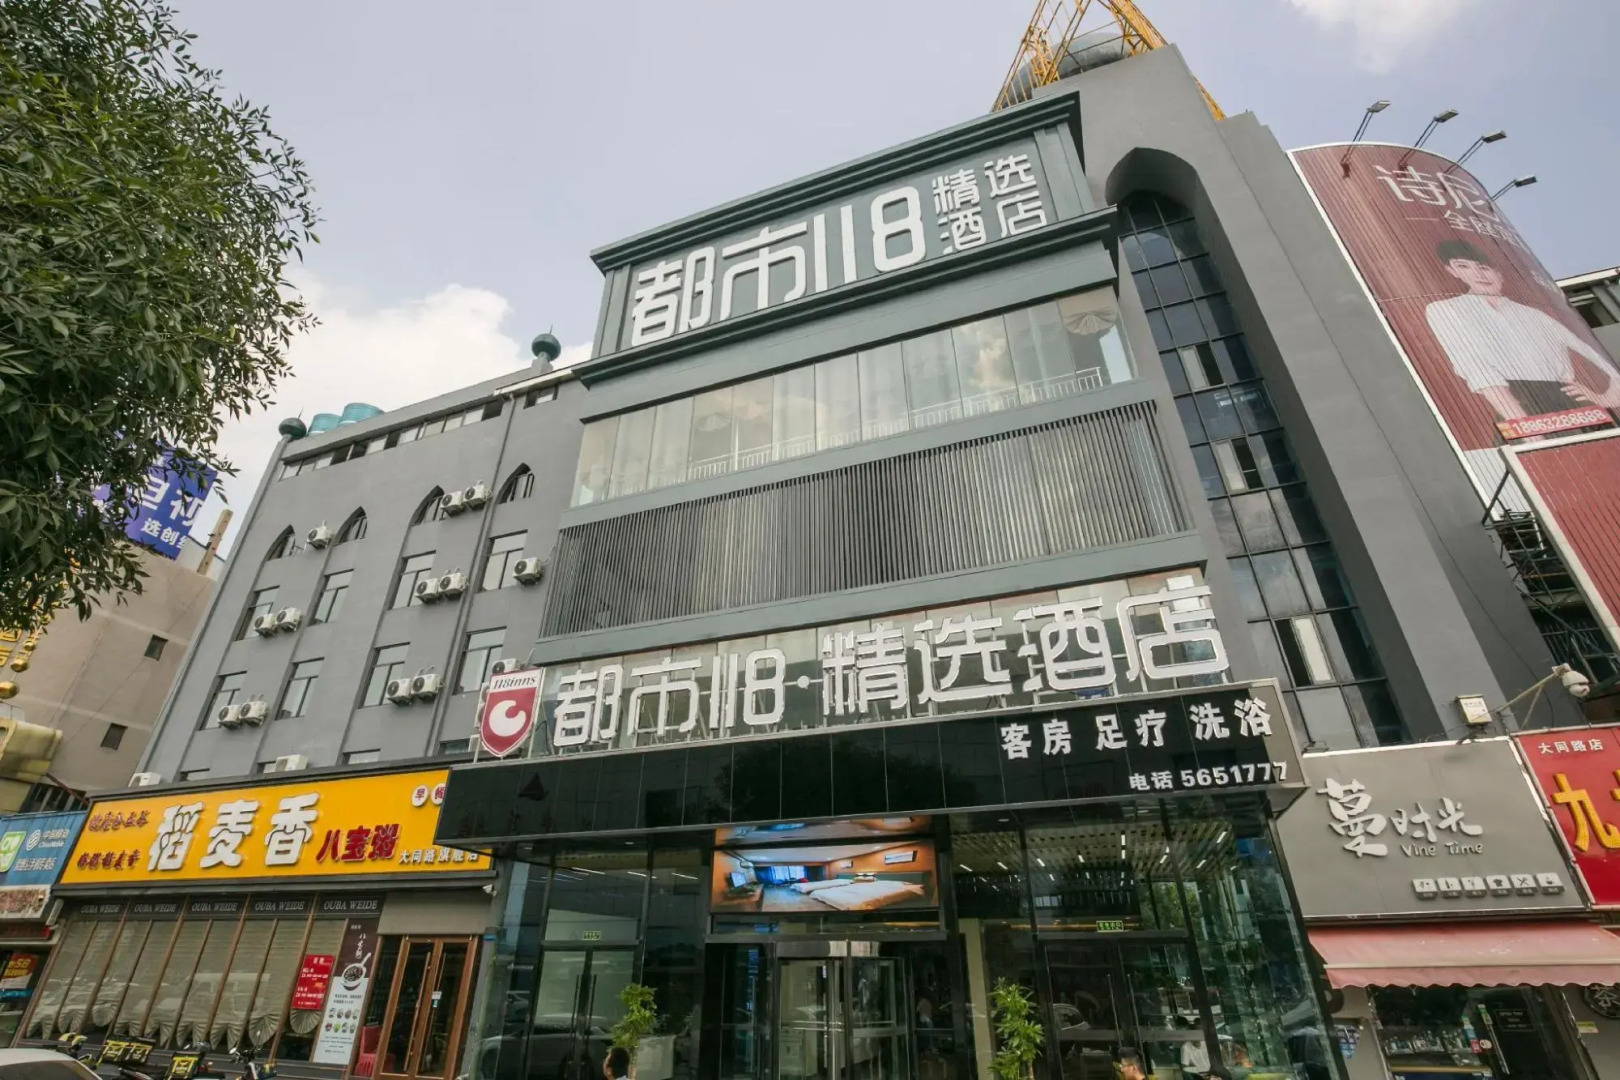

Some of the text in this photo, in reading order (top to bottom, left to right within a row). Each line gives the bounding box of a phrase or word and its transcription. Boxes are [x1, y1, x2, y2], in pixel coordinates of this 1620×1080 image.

[933, 154, 1036, 214] 精选
[1372, 164, 1501, 222] 诗尼
[937, 197, 1048, 255] 酒店
[631, 185, 927, 347] 都市118
[1000, 697, 1274, 760] 客房 足疗 洗浴
[1538, 738, 1604, 755] 大同路店
[1129, 760, 1288, 792] 电话 5651777
[147, 792, 320, 871] 稻麦香
[1552, 768, 1620, 852] 九
[316, 824, 400, 863] 八宝粥
[1400, 841, 1483, 858] Vine Time
